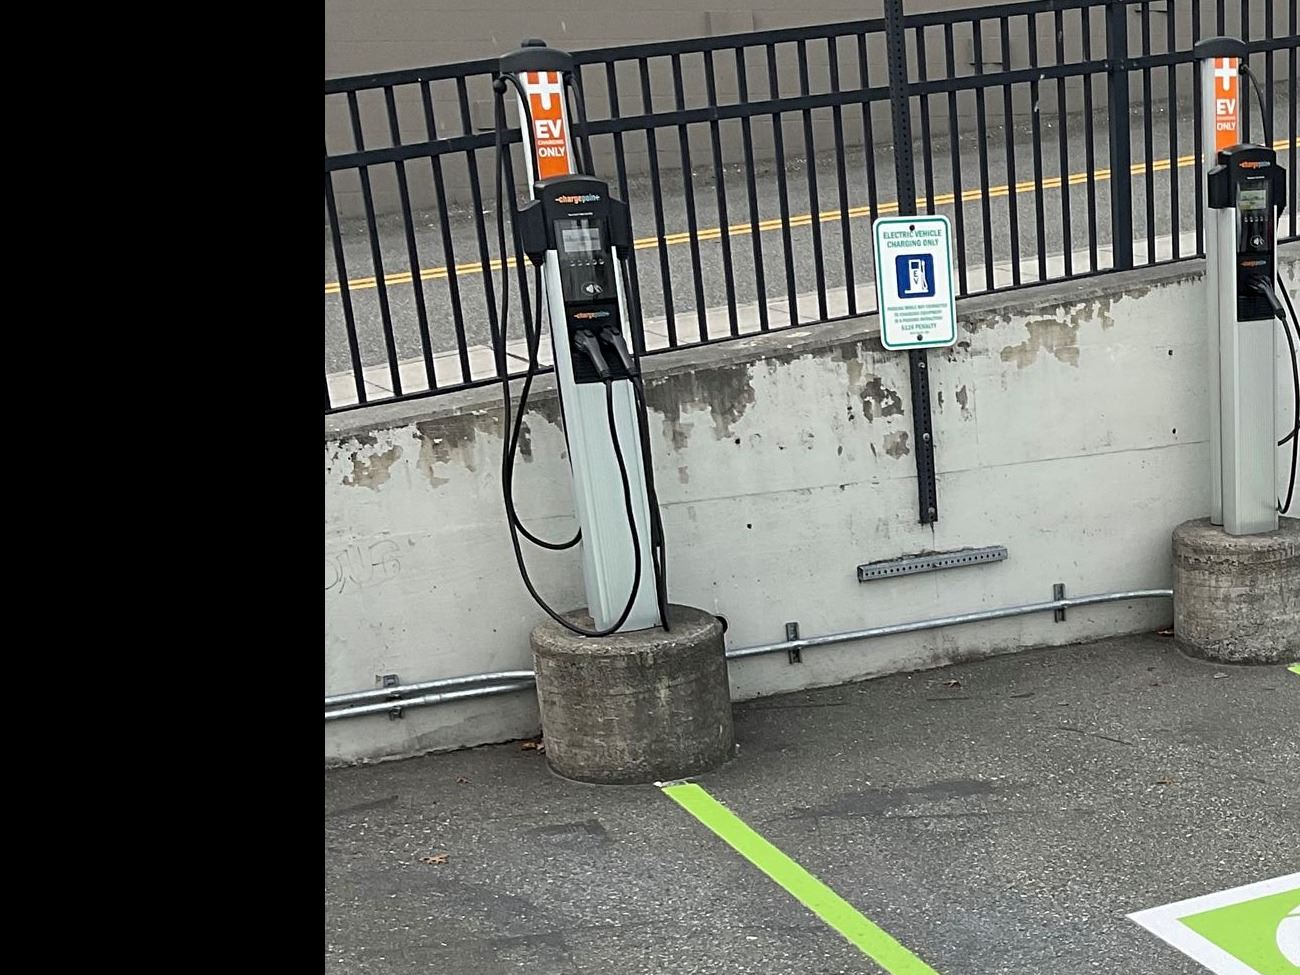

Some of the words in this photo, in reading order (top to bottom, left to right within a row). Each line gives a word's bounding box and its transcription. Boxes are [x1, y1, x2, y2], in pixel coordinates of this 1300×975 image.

[1216, 98, 1236, 115] EV
[534, 119, 562, 139] EV
[1216, 122, 1236, 131] ONLY
[538, 146, 565, 158] ONLY
[883, 230, 914, 239] ELECTRIC
[914, 229, 942, 238] VEHICLE
[887, 240, 921, 249] CHARGING
[922, 238, 939, 247] ONLY
